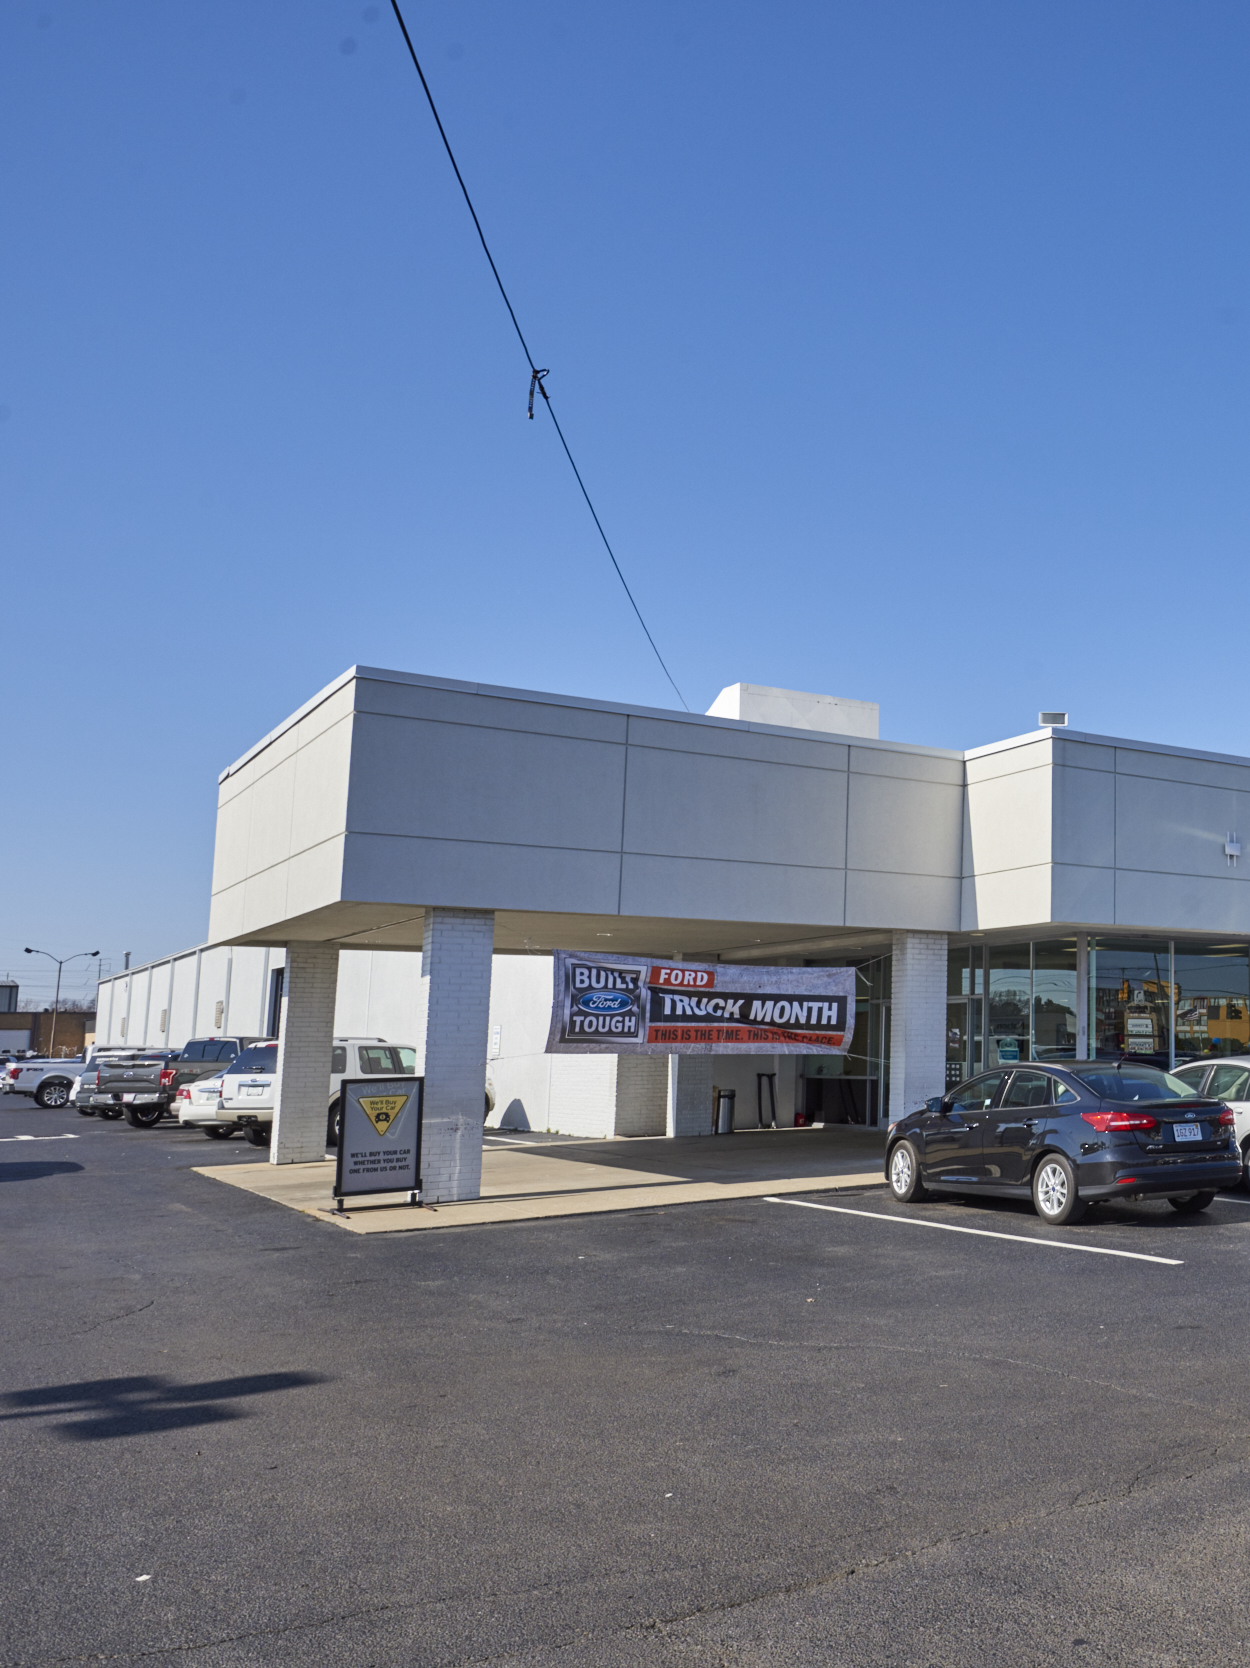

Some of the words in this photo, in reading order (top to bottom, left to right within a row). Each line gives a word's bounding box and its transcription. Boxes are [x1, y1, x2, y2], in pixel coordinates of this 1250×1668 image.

[575, 967, 636, 989] BUILT
[658, 969, 709, 986] FORD
[589, 994, 622, 1008] Ford
[659, 993, 746, 1019] TRUCK
[749, 1000, 838, 1025] MONTH
[572, 1016, 636, 1033] TOUGH
[654, 1029, 679, 1041] THIS
[681, 1029, 692, 1041] IS
[694, 1029, 714, 1041] THE
[716, 1029, 744, 1041] TIME.
[747, 1029, 769, 1041] THIS
[770, 1031, 781, 1041] IS
